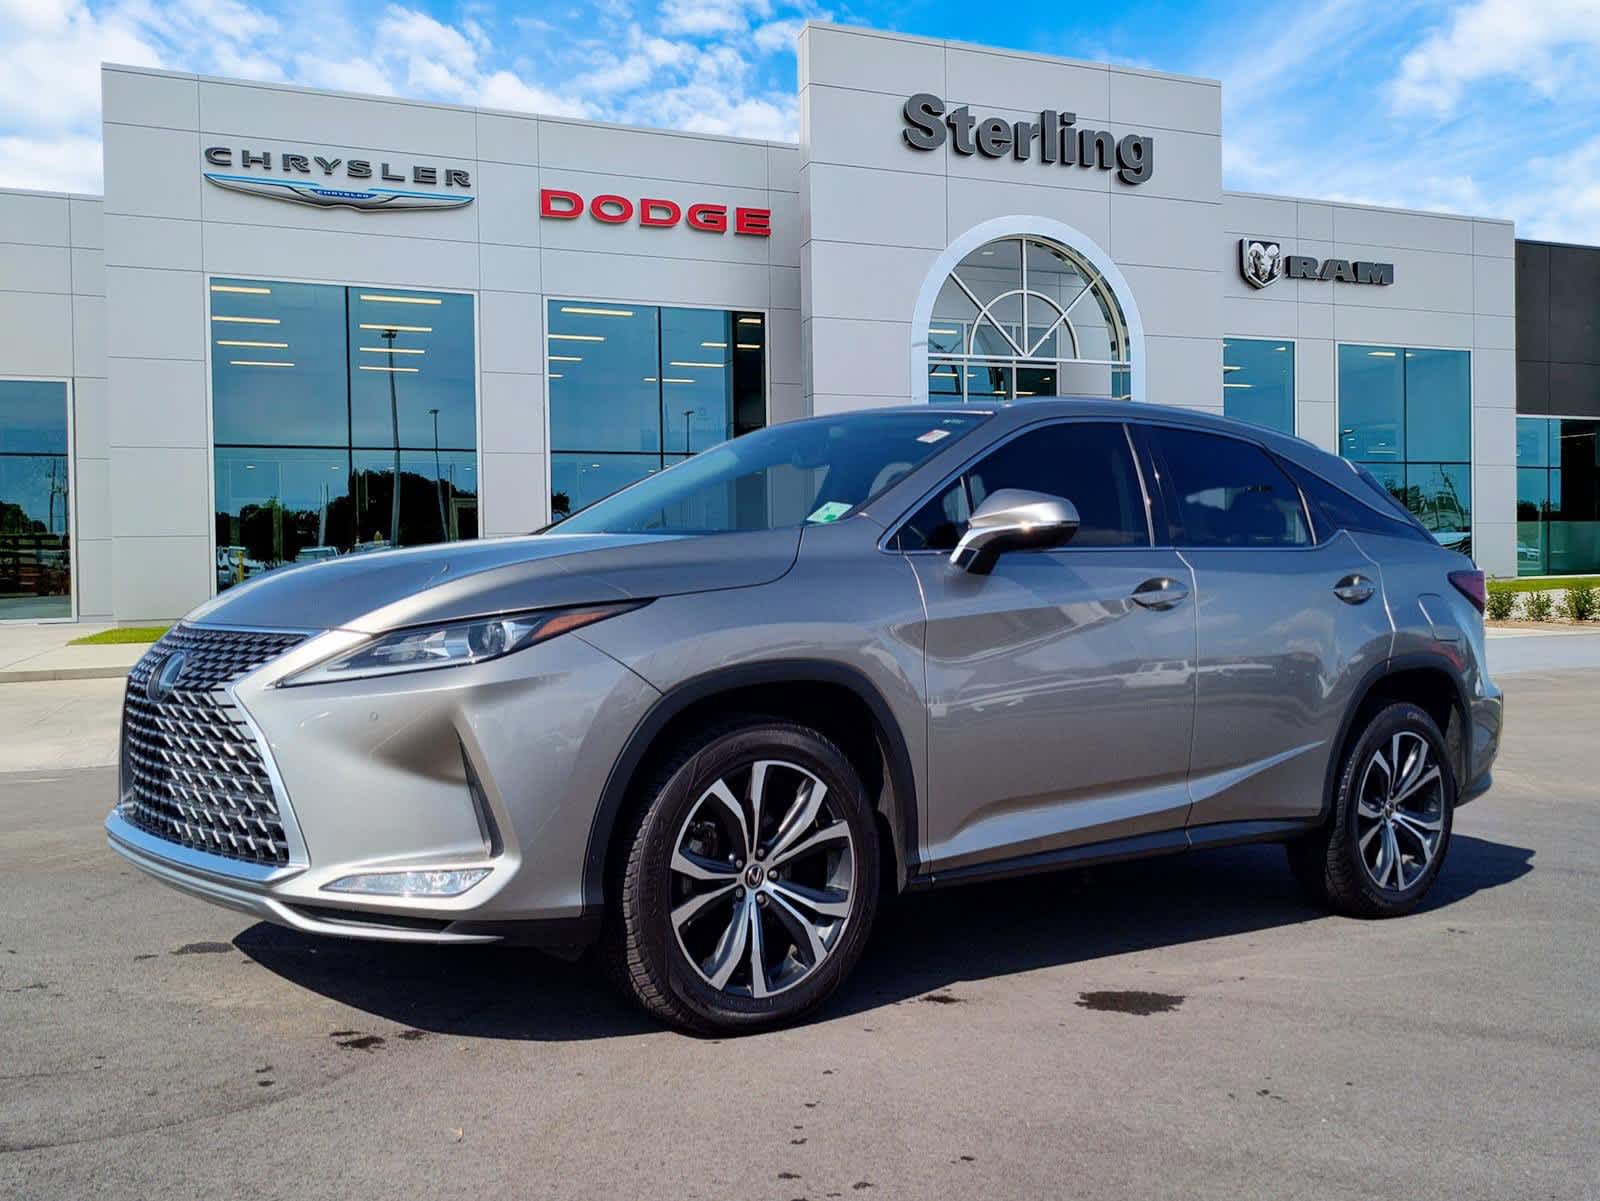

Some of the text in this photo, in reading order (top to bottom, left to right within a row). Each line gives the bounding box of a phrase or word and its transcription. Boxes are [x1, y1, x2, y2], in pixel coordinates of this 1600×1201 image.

[903, 93, 1154, 185] Sterling
[204, 146, 472, 188] CHRYSLER
[540, 188, 771, 237] DODGE
[1285, 255, 1395, 286] RAM
